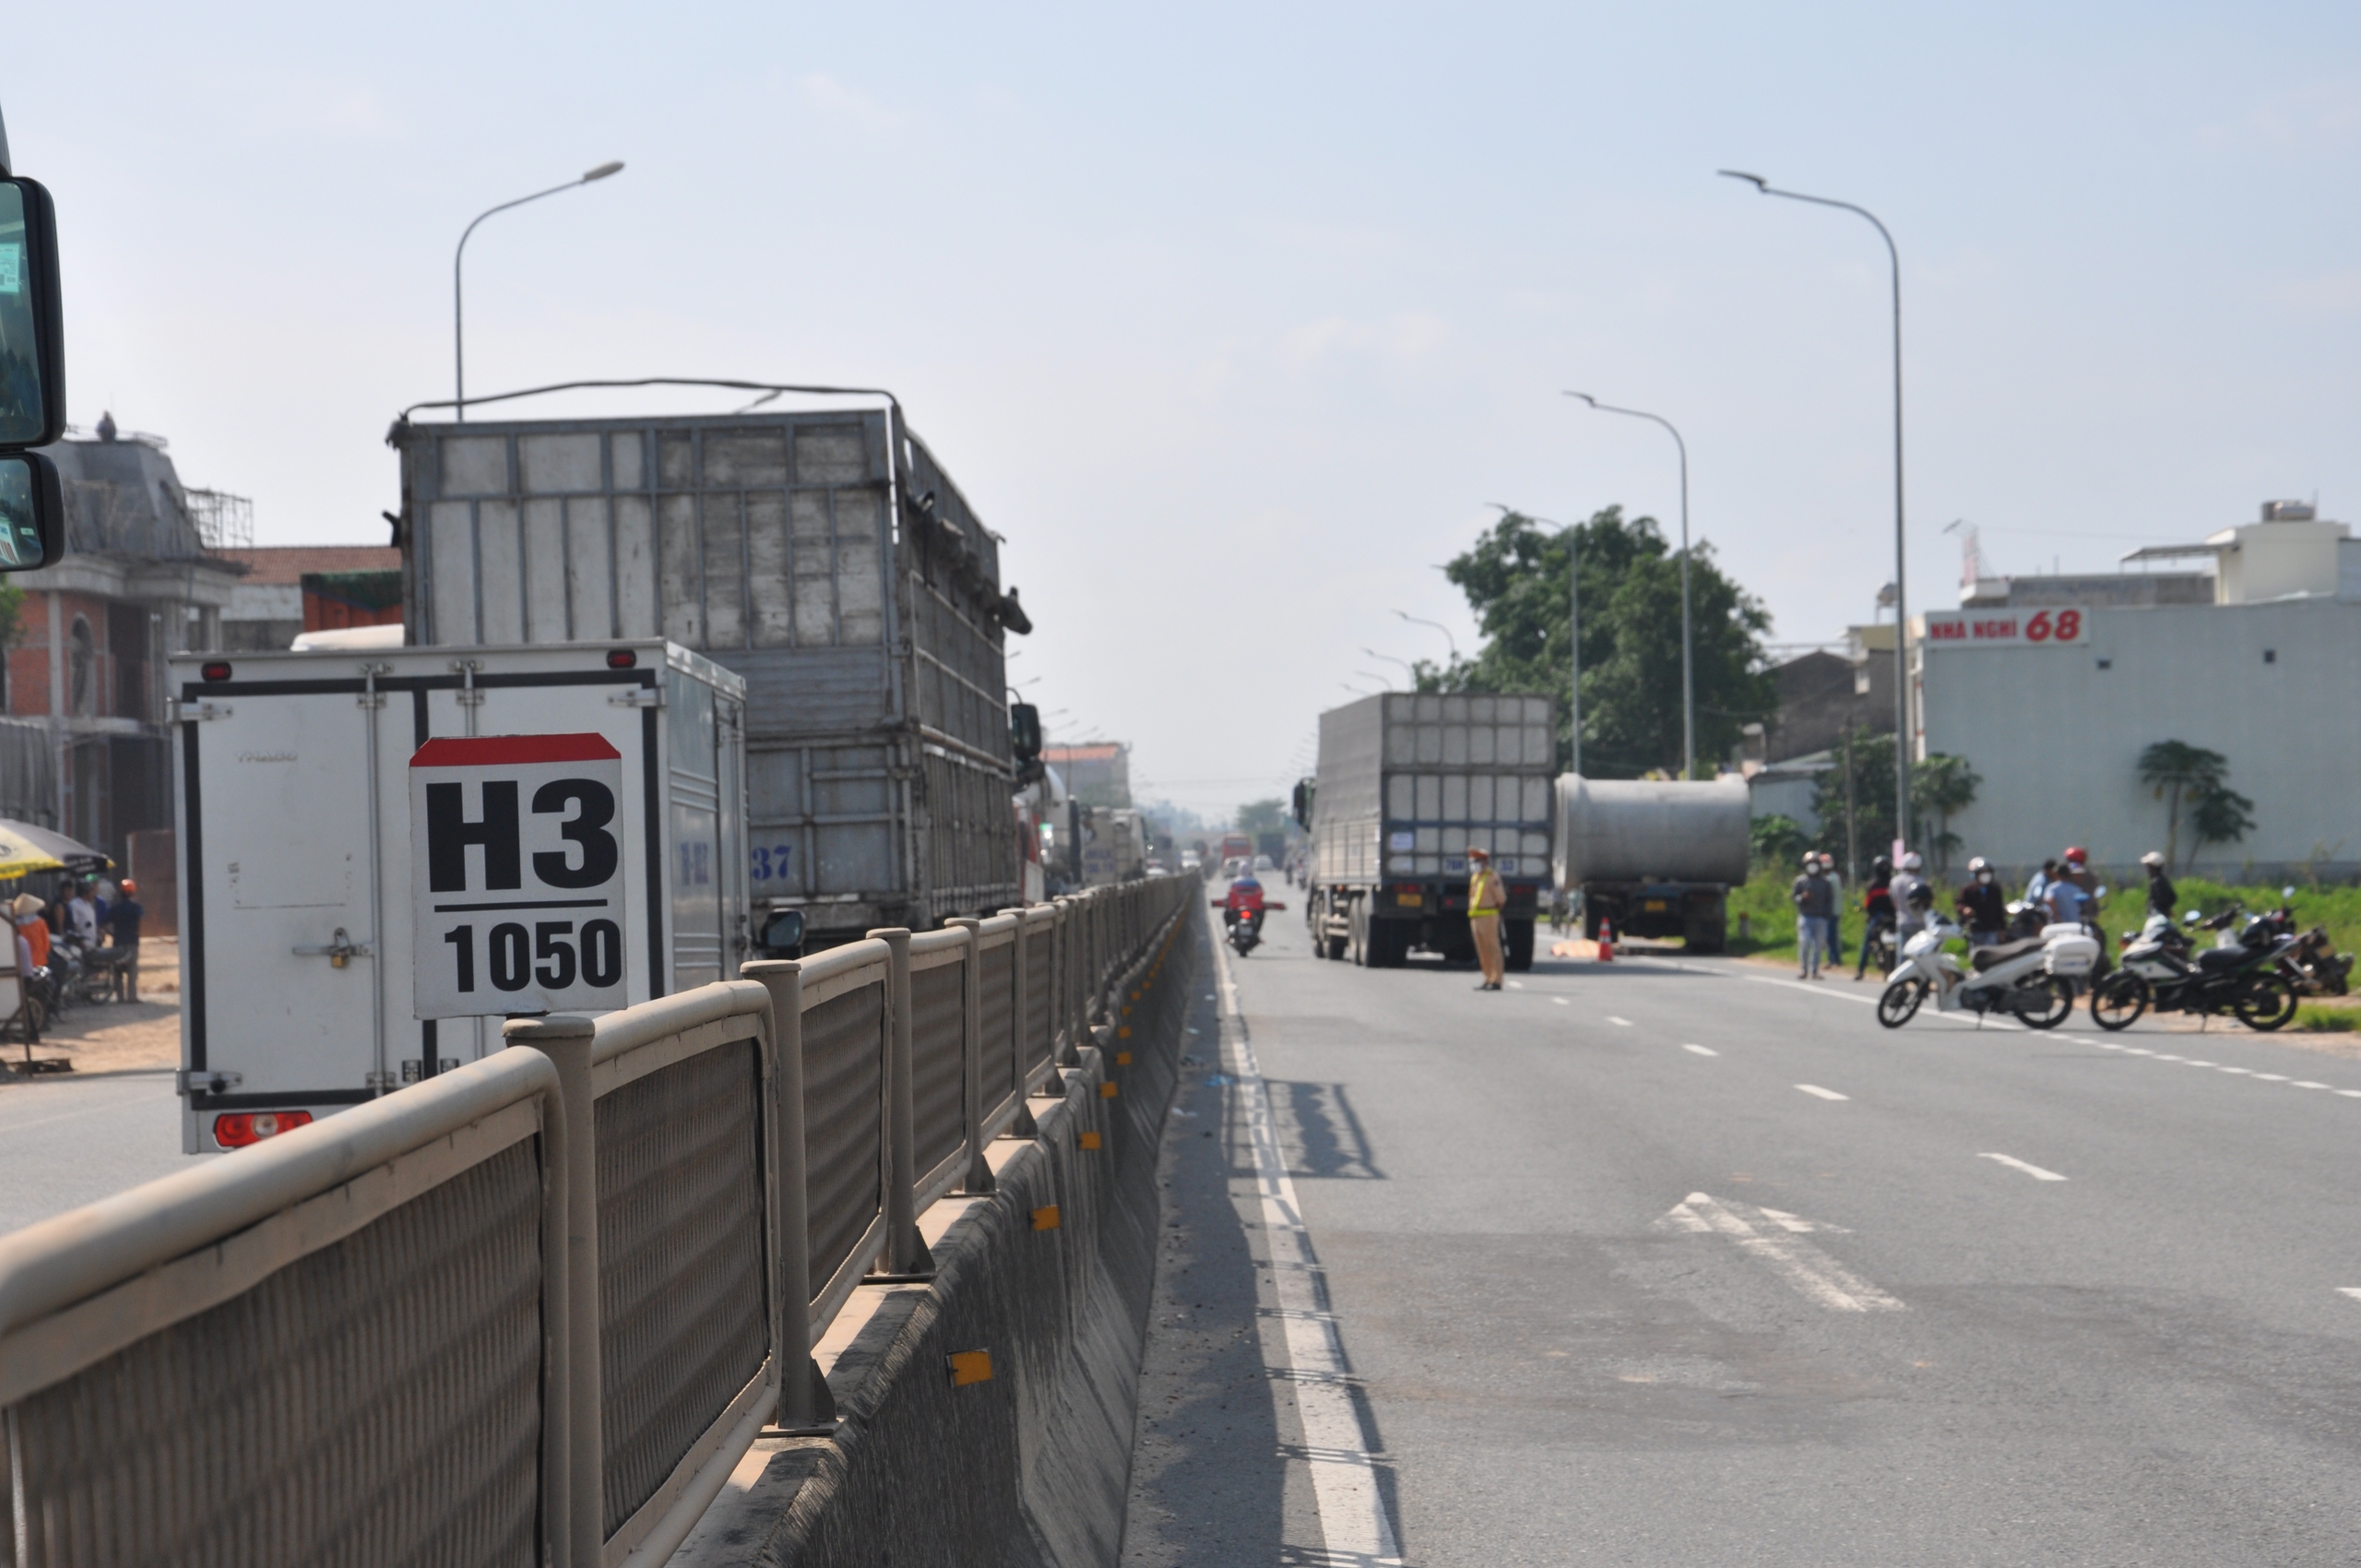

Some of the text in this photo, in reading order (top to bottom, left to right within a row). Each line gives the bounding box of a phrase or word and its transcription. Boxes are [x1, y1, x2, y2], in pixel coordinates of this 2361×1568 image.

[2025, 610, 2081, 642] 68
[426, 778, 618, 892] H3
[752, 845, 792, 881] 37
[445, 919, 623, 992] 1050
